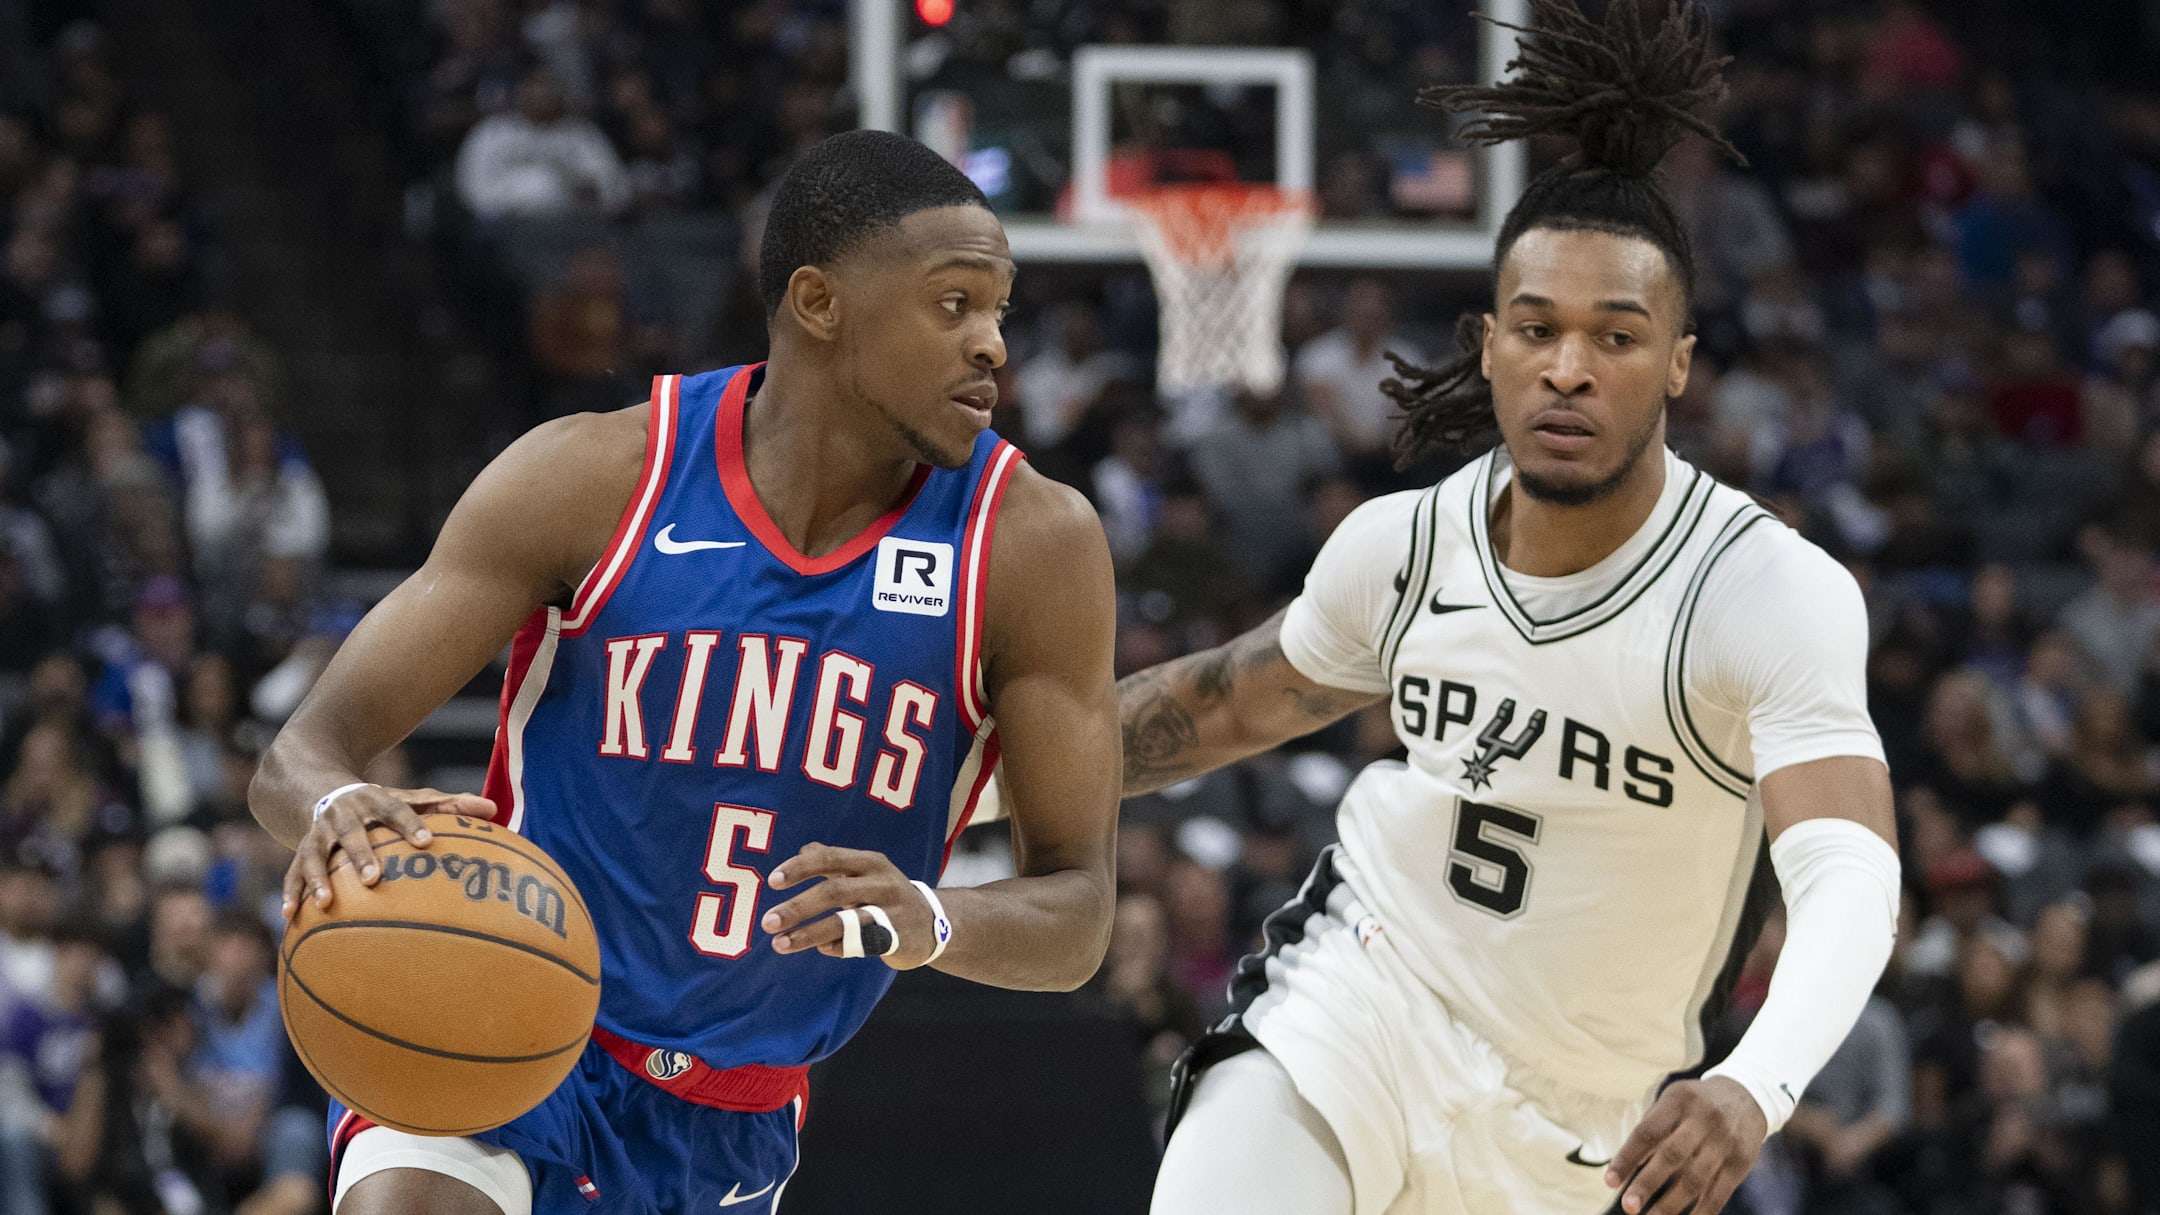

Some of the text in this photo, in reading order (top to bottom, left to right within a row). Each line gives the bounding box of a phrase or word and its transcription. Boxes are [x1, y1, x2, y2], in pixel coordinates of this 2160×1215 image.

[878, 592, 944, 607] REVIVER
[893, 549, 936, 587] R
[598, 629, 940, 811] KINGS
[1399, 674, 1674, 808] SPURS
[688, 801, 779, 960] 5
[1443, 795, 1544, 921] 5
